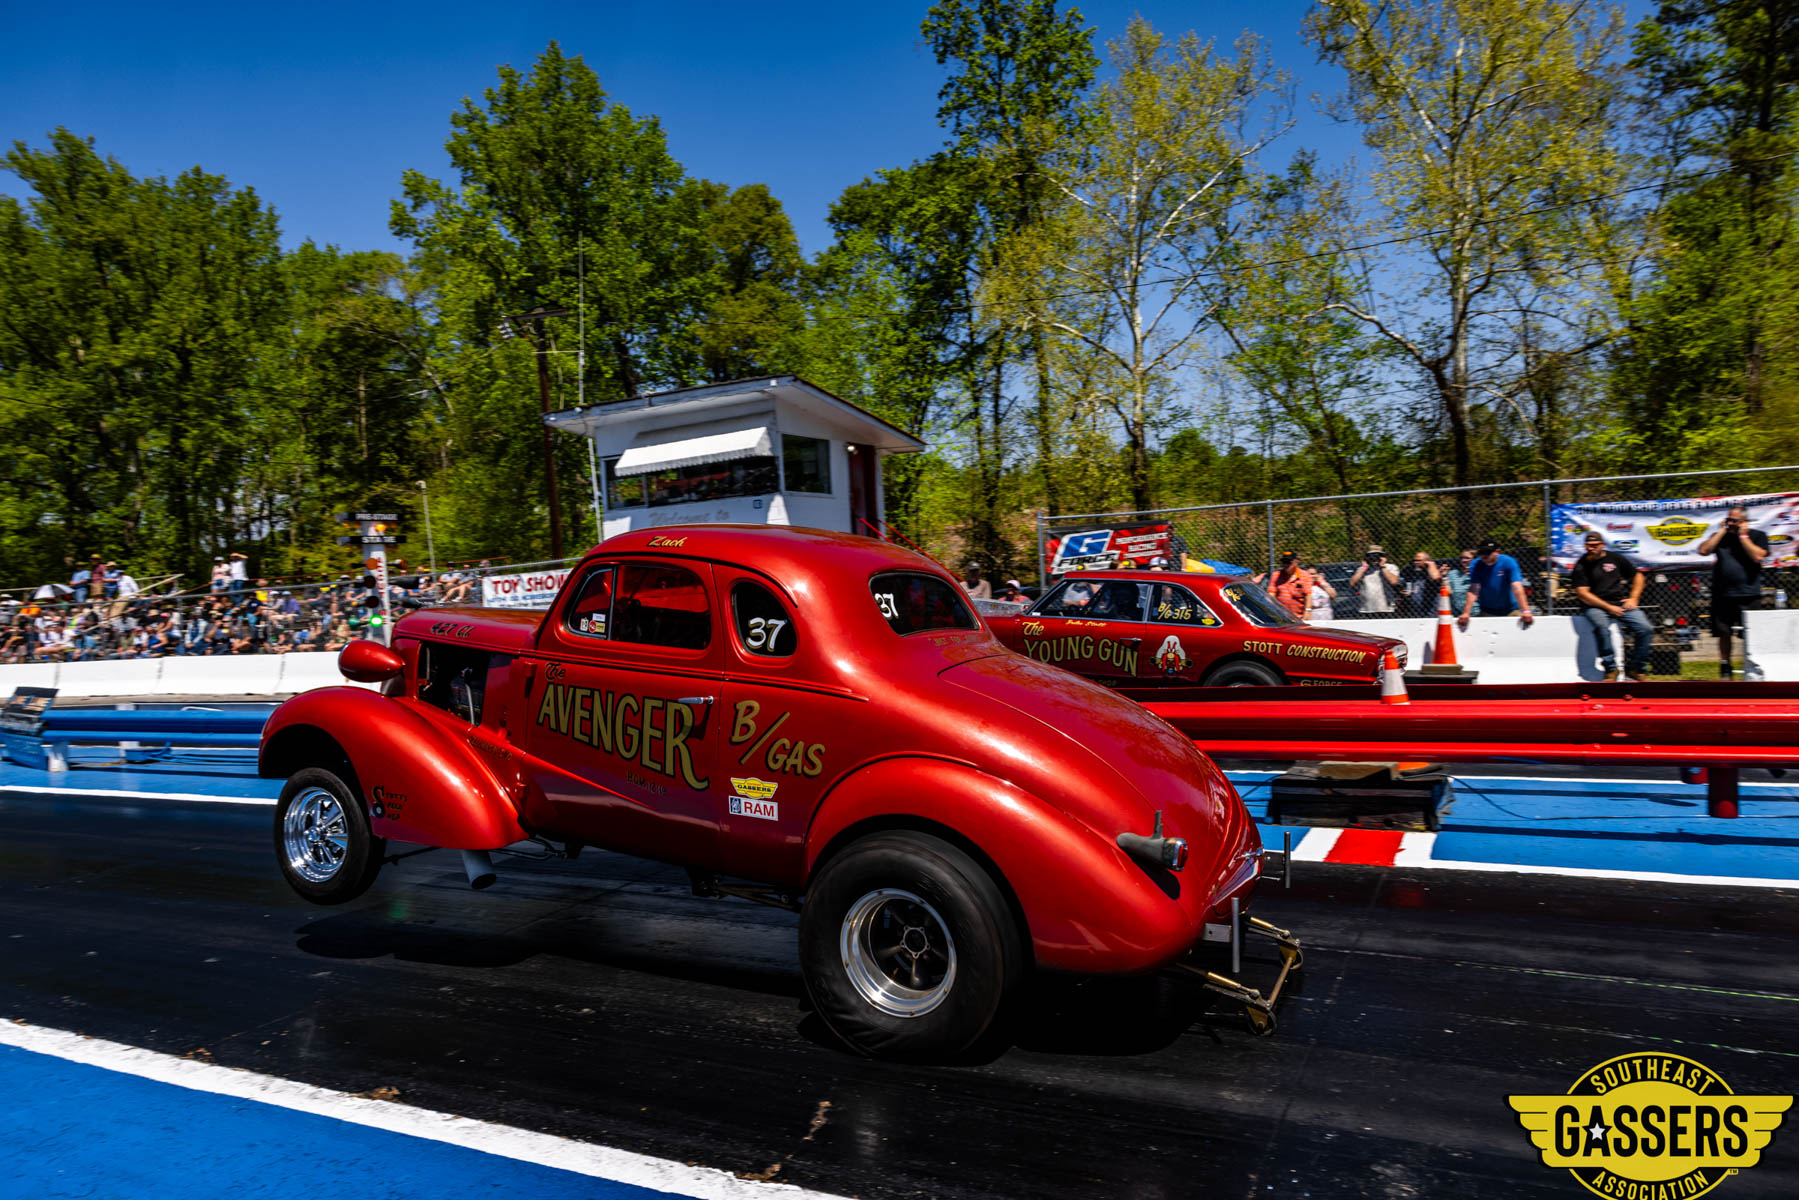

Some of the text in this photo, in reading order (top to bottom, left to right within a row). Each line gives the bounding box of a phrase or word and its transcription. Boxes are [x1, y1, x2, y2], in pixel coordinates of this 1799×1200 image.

[646, 535, 688, 547] Zach
[492, 578, 520, 595] TOY
[874, 592, 899, 620] 37
[745, 616, 787, 652] 37
[1022, 621, 1045, 635] The
[1023, 635, 1139, 678] YOUNG GUN
[1242, 640, 1366, 664] STOTT CONSTRUCTION
[545, 662, 567, 681] The
[536, 682, 710, 791] AVENGER
[736, 783, 772, 793] GASSERS
[743, 801, 775, 817] RAM
